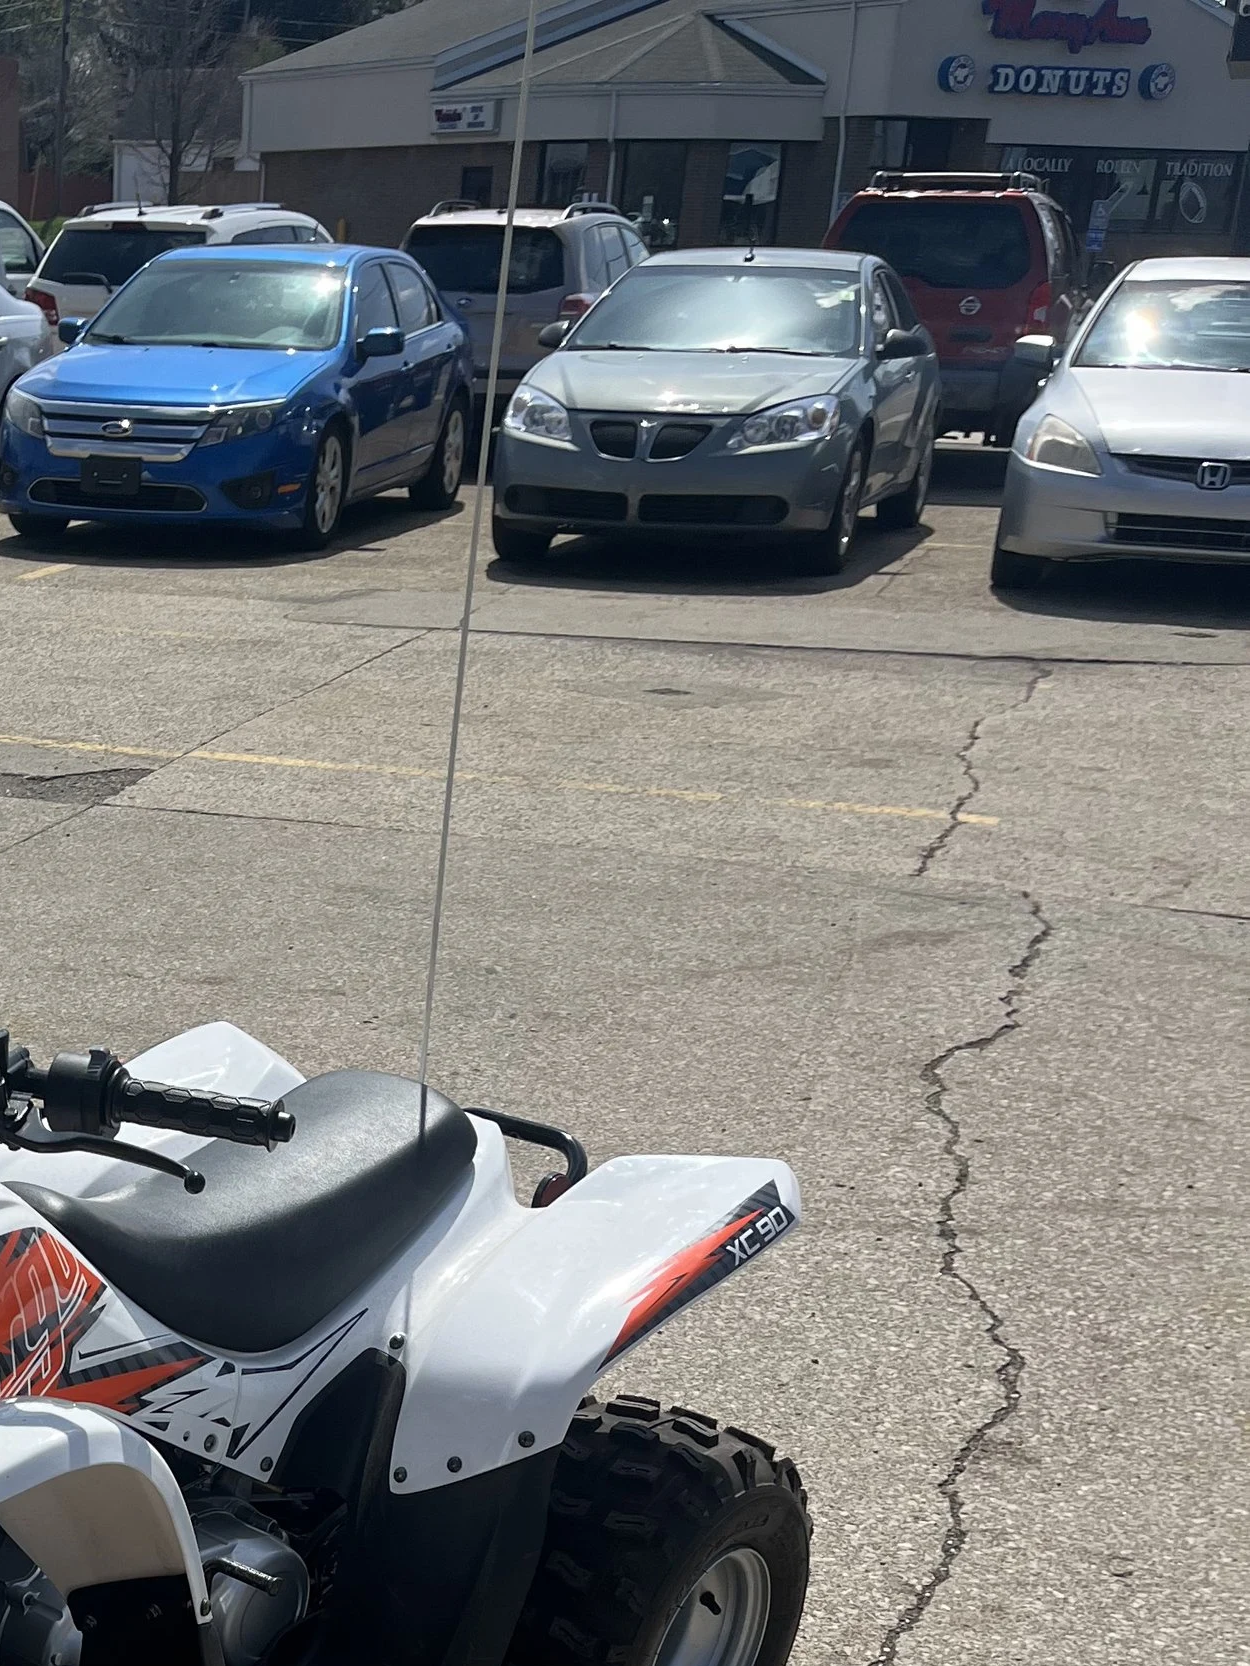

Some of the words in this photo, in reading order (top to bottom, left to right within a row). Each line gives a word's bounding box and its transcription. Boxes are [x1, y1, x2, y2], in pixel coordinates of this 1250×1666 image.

[993, 67, 1130, 97] DONUTS
[1165, 161, 1234, 177] TRADITION
[726, 1228, 761, 1266] XC
[755, 1206, 790, 1242] 90
